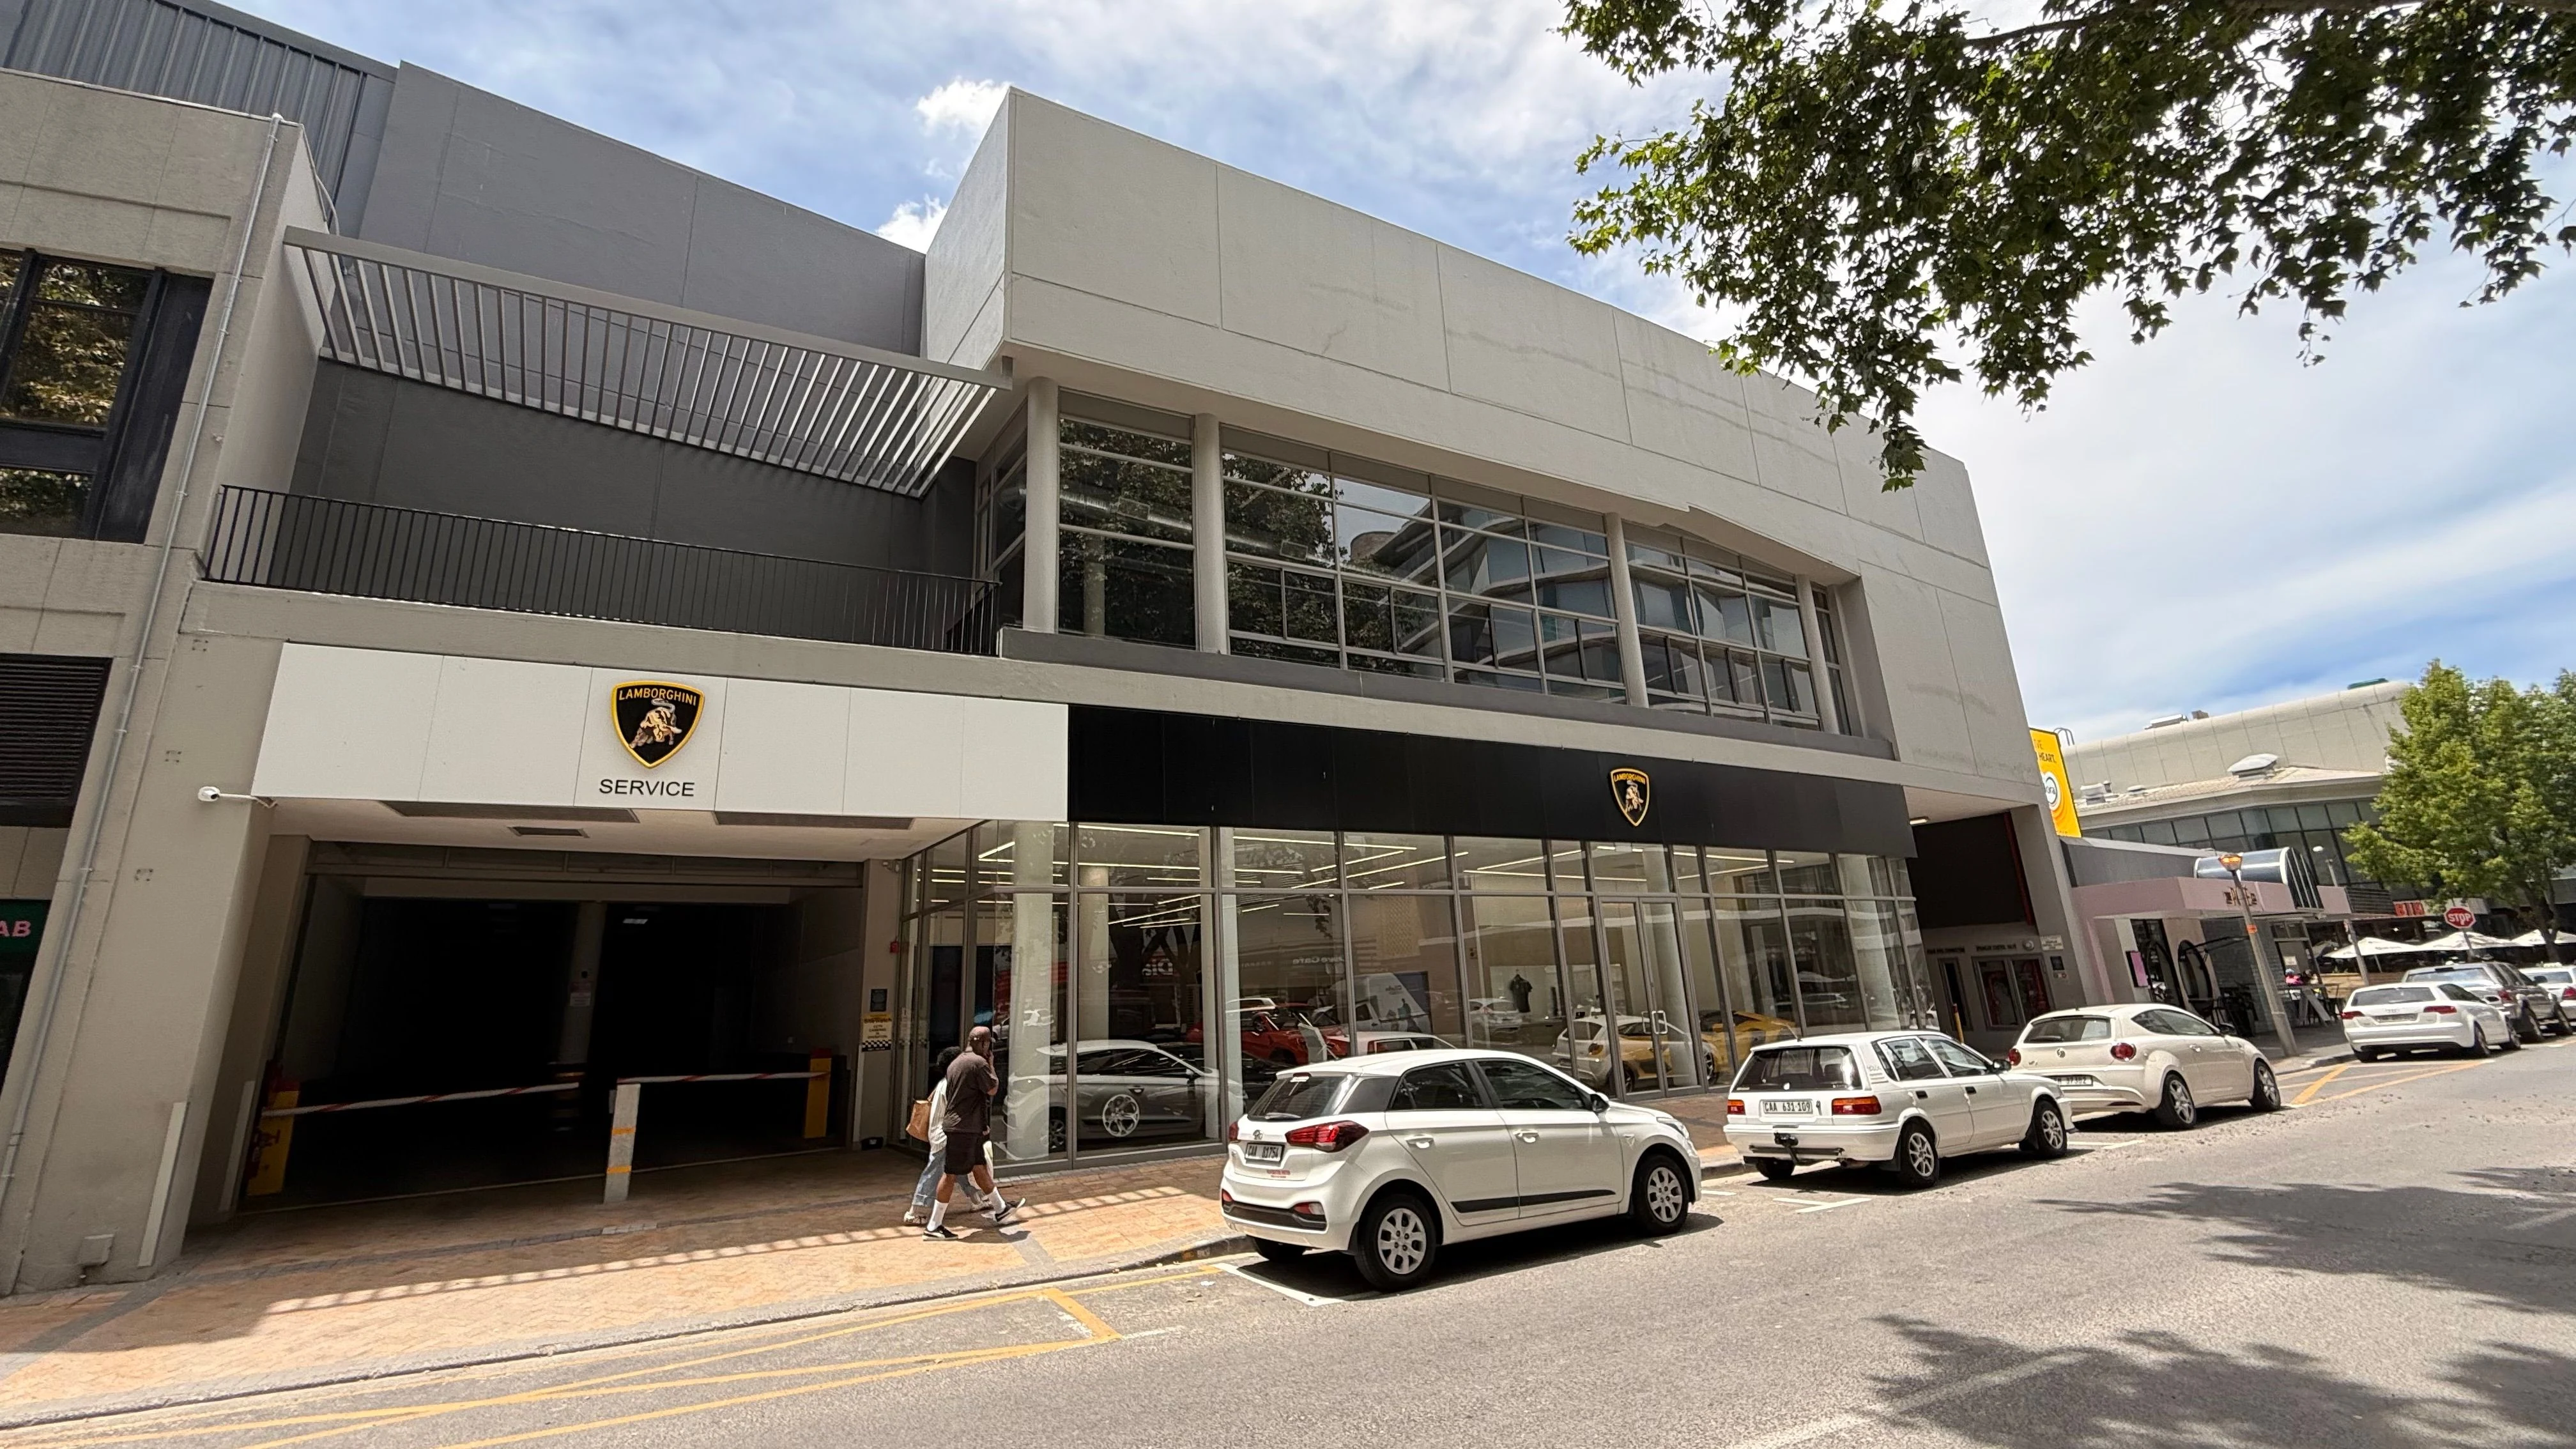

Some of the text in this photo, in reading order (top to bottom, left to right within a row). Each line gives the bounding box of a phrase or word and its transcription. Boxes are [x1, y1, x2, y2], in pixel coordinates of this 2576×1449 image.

[619, 688, 697, 706] LAMBORGHINI
[599, 779, 695, 797] SERVICE
[2448, 914, 2471, 922] STOP
[1765, 1102, 1777, 1112] CAA
